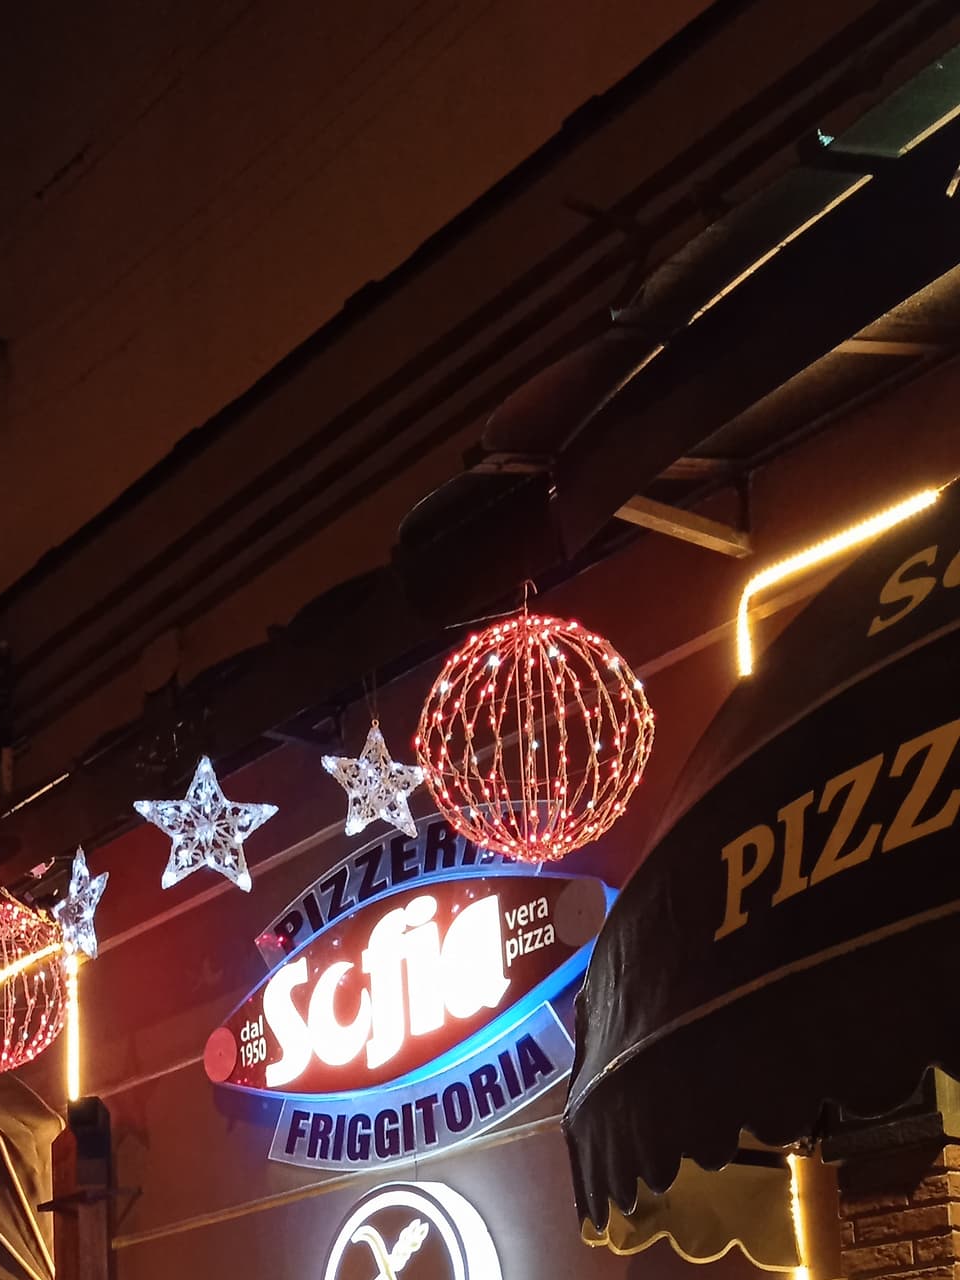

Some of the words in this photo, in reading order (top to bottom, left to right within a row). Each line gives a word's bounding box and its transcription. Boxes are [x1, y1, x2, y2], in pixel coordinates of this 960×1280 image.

[505, 894, 549, 929] vera
[505, 922, 556, 968] pizza
[262, 894, 511, 1088] Sofia
[239, 1015, 265, 1044] dal
[239, 1042, 267, 1068] 1950
[284, 1032, 556, 1161] FRIGGITORIA
